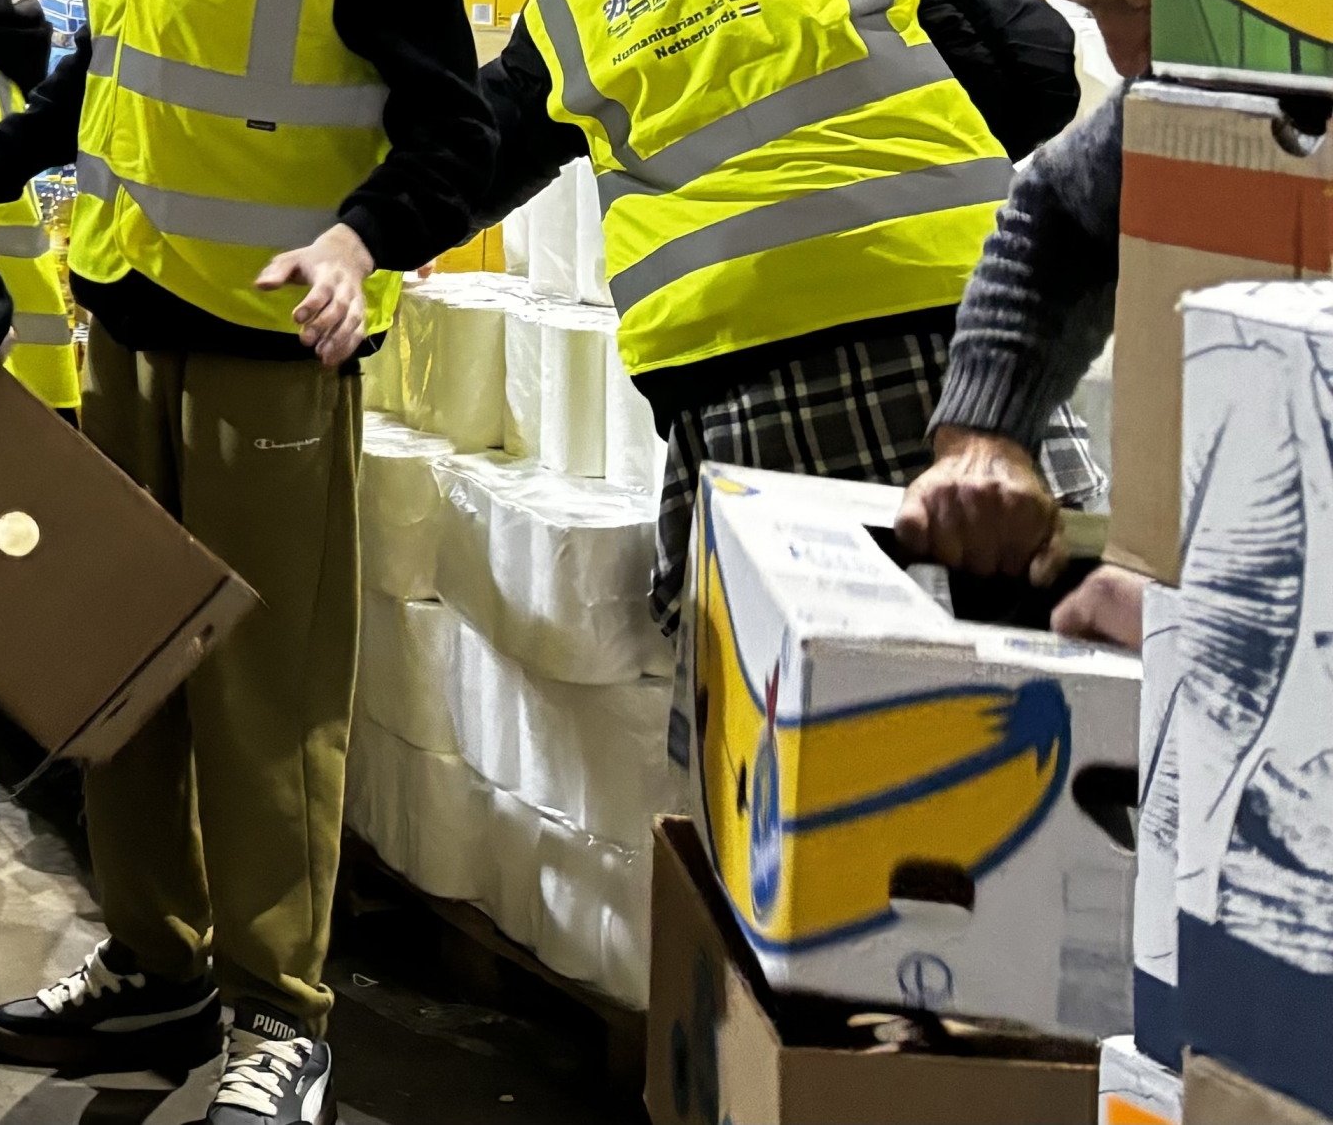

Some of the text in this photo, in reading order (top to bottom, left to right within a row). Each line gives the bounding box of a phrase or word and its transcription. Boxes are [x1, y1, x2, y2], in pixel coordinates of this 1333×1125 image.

[612, 10, 704, 66] Humanitarian
[653, 7, 738, 60] Netherlands
[252, 1013, 297, 1040] PUMA
